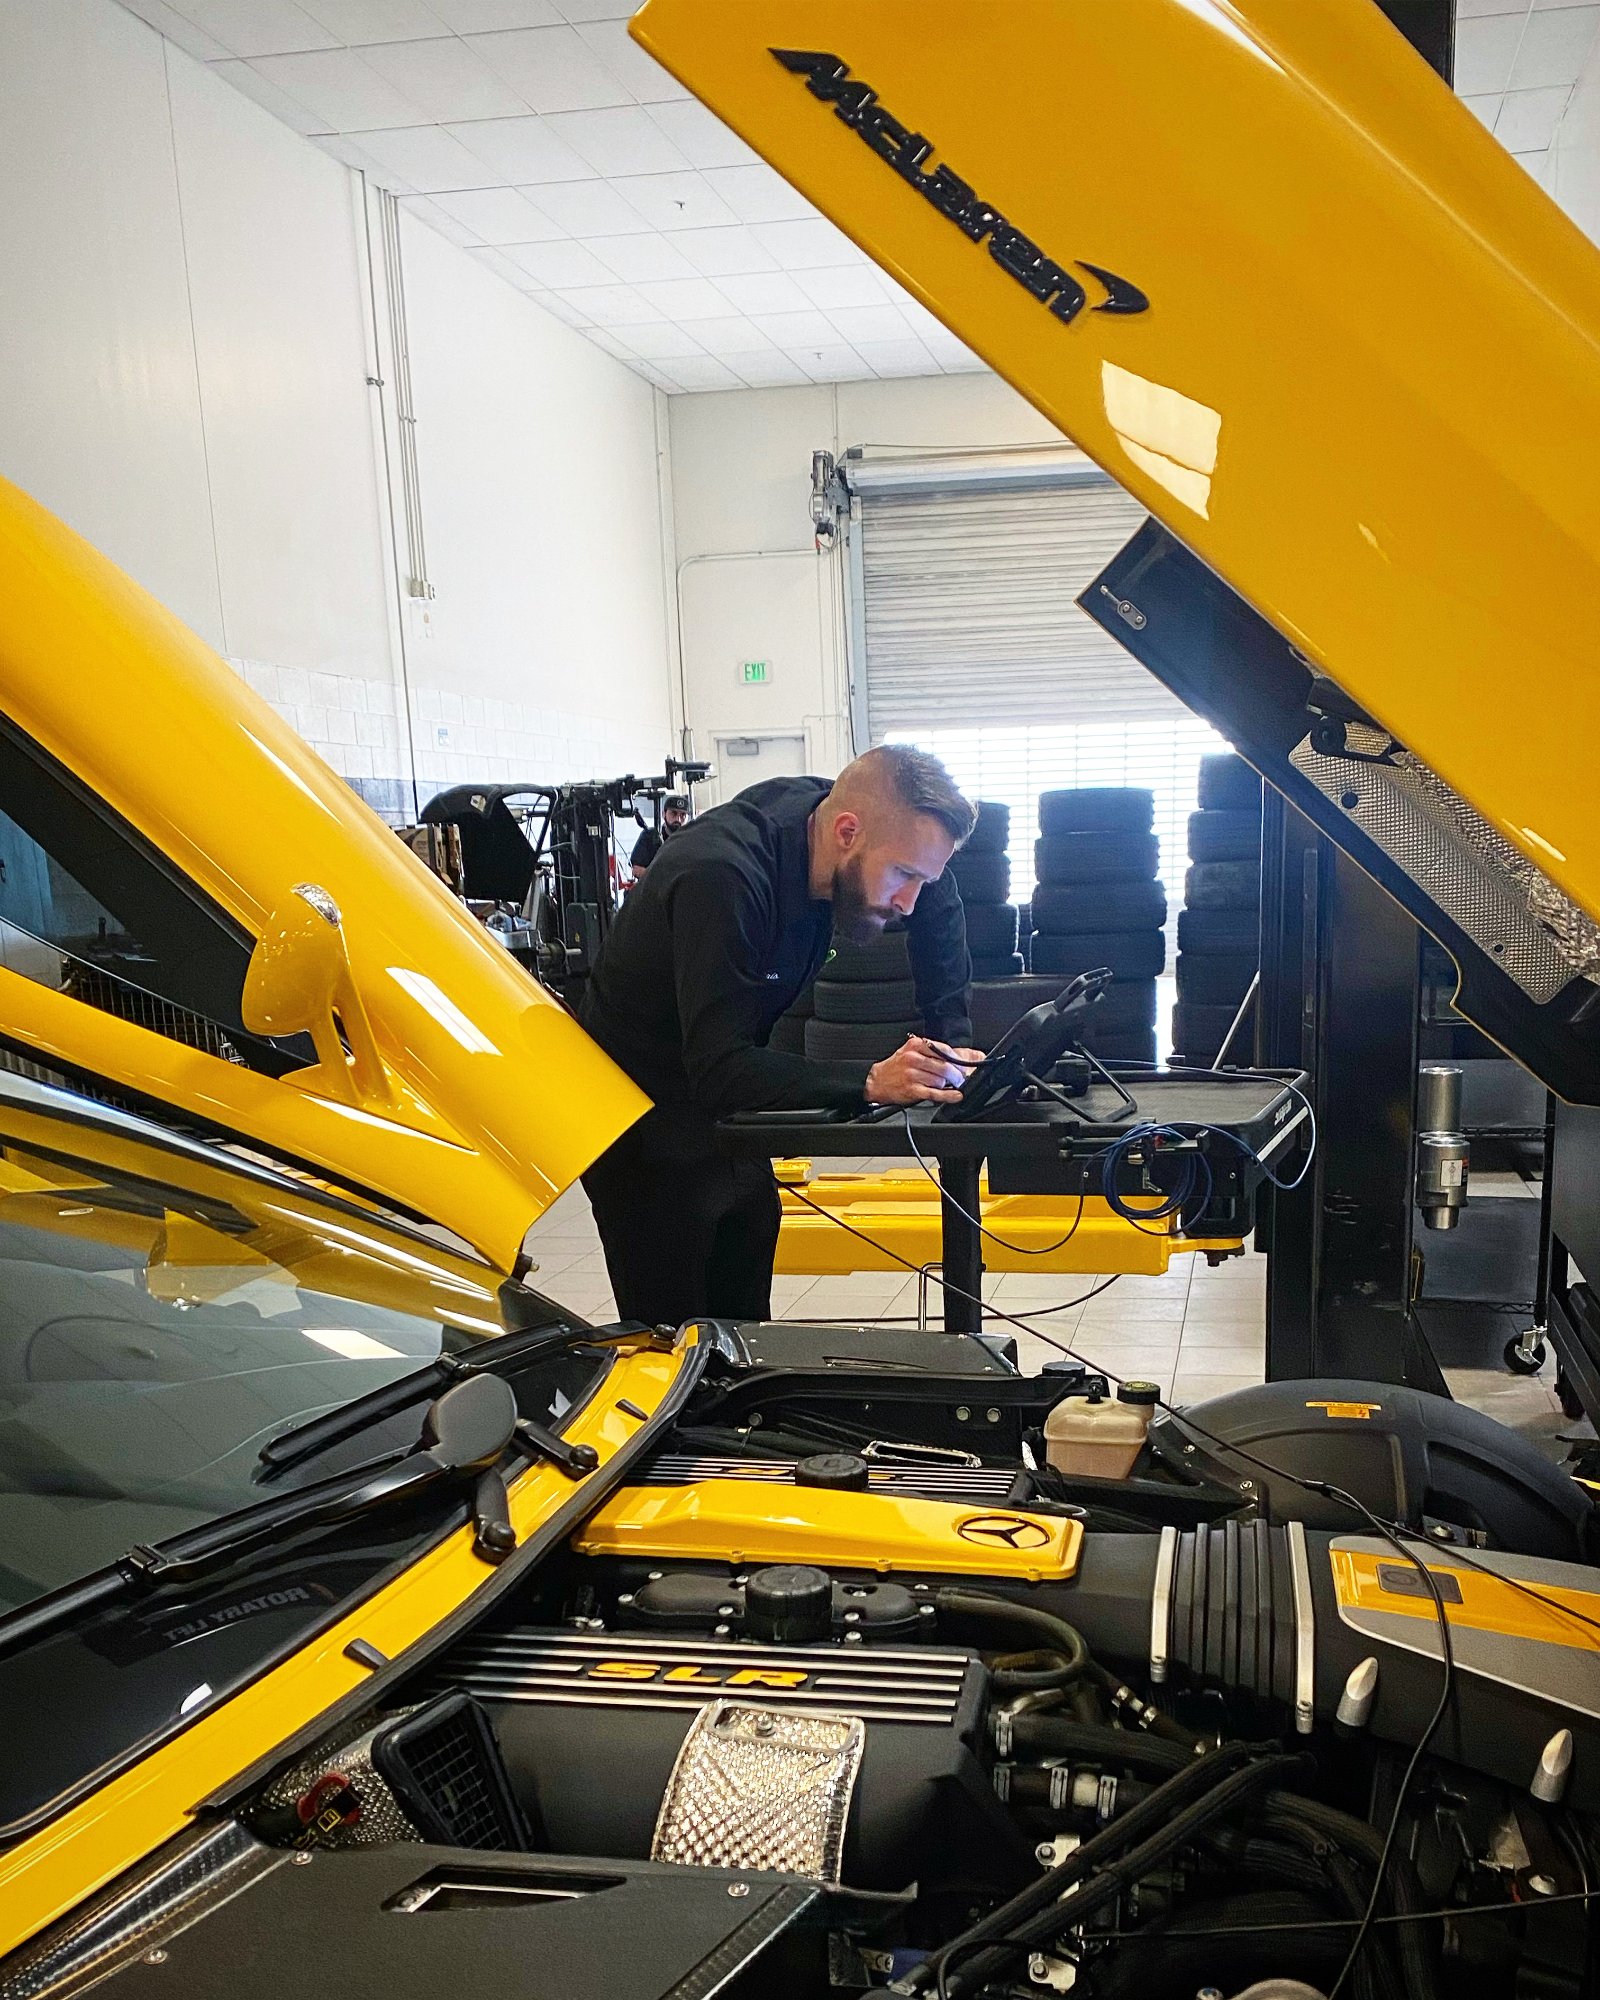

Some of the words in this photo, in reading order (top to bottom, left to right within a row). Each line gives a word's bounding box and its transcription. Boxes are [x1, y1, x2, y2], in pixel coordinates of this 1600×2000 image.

[767, 47, 1086, 325] McLaren
[745, 663, 766, 681] EXIT
[587, 1661, 809, 1689] SLR
